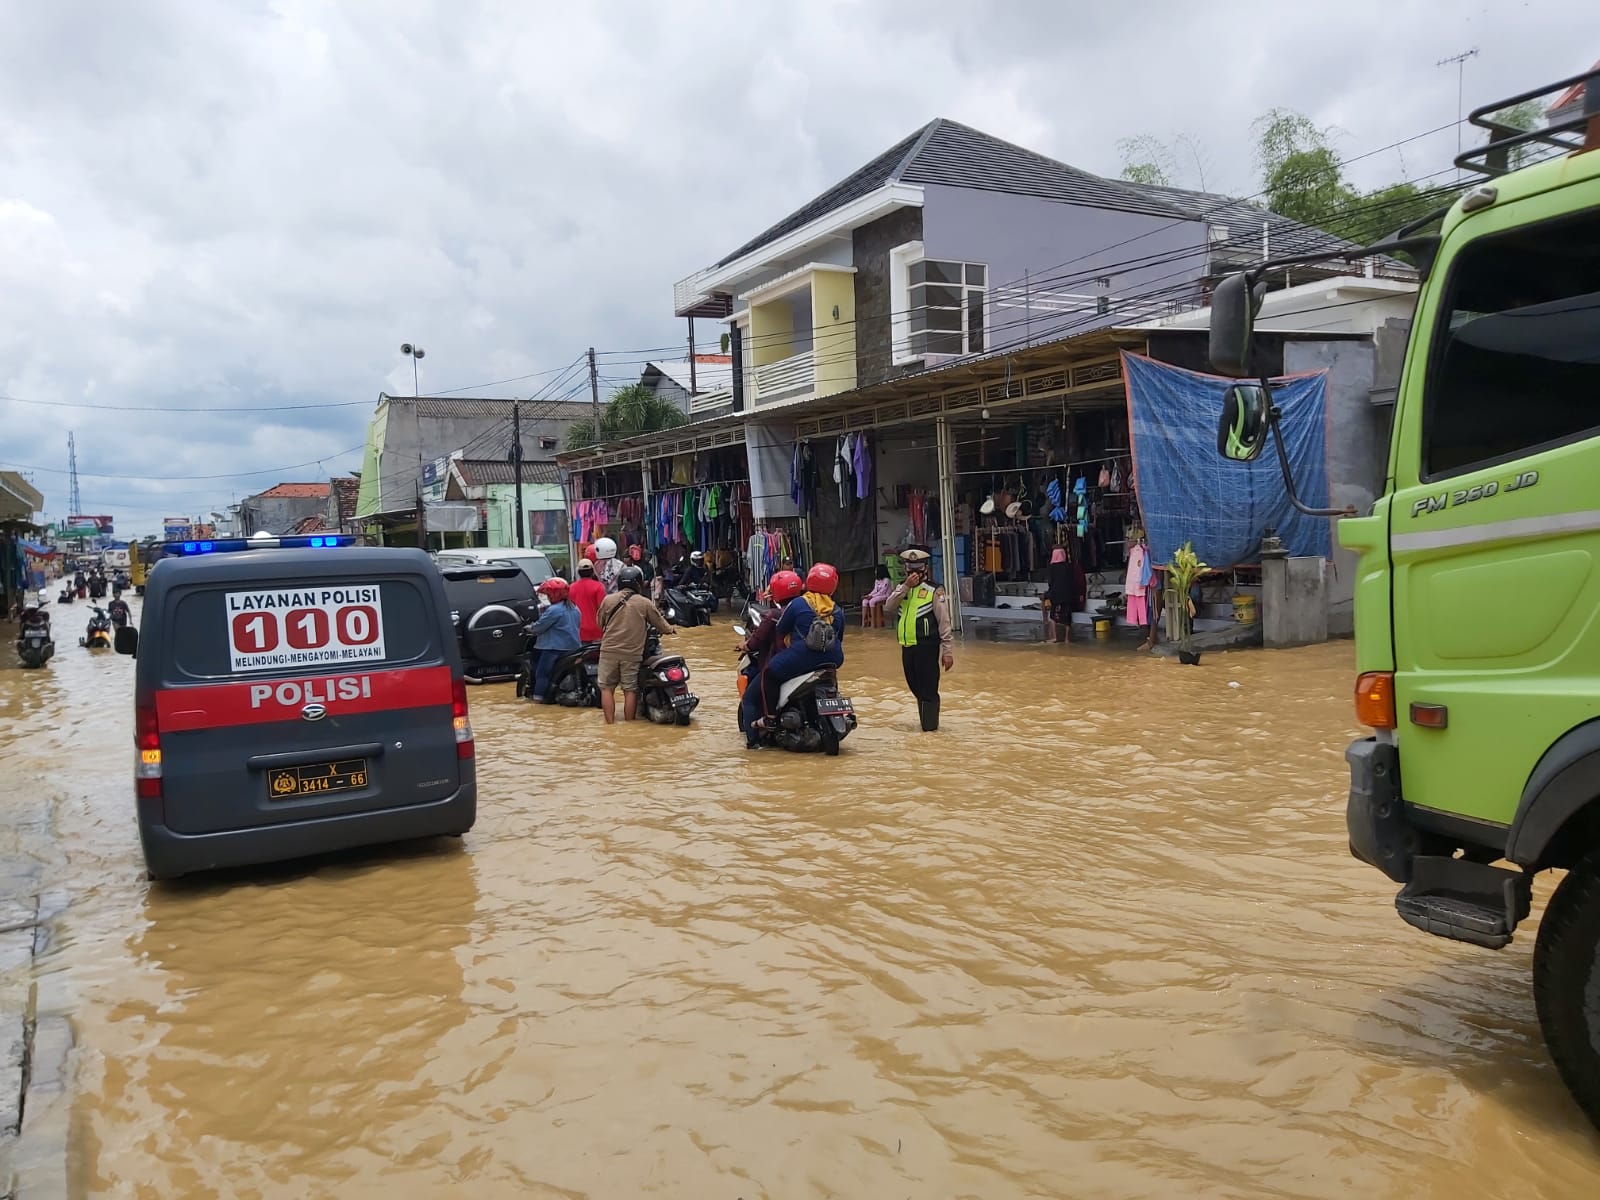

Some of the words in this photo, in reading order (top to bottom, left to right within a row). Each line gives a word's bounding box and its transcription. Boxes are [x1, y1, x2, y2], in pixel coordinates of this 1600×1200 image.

[1411, 492, 1448, 518] FM
[1452, 481, 1499, 507] 260
[1503, 470, 1539, 493] JD
[230, 592, 316, 611] LAYANAN
[321, 589, 377, 605] POLISI
[245, 609, 370, 649] 110
[250, 676, 371, 709] POLISI
[302, 777, 329, 792] 3414
[350, 773, 364, 785] 66
[329, 763, 337, 776] X
